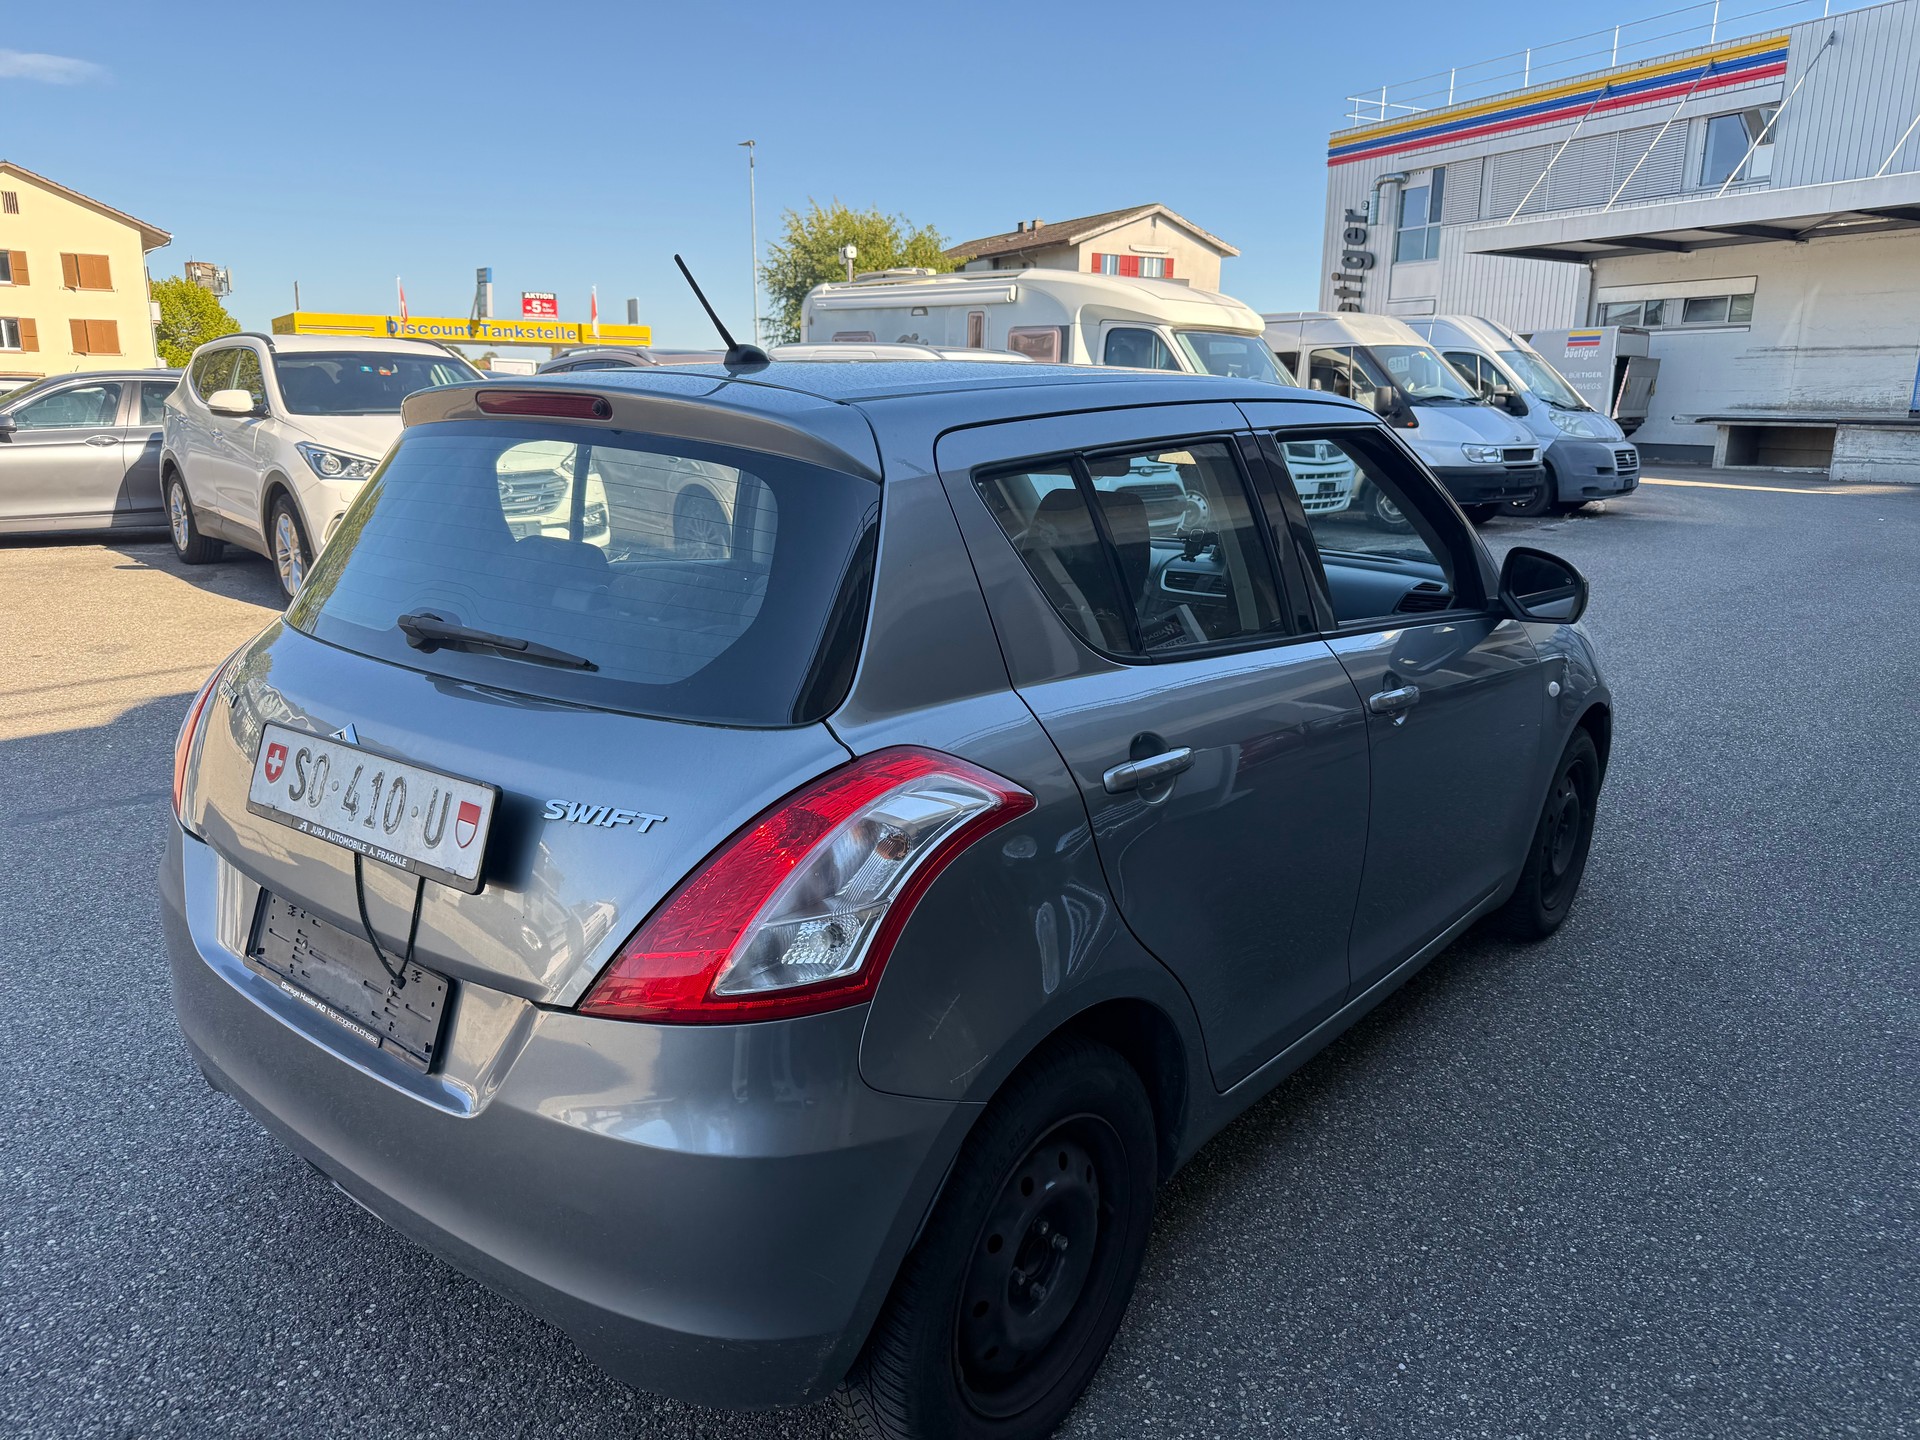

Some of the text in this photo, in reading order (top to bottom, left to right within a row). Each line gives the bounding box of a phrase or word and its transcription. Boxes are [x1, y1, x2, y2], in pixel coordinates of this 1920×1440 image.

[525, 292, 554, 300] AKTION
[543, 799, 668, 833] SWIFT
[310, 827, 326, 838] JURA
[327, 831, 367, 853] AUTOMOBILE
[376, 849, 408, 868] FRAGALE
[316, 1002, 327, 1013] AG
